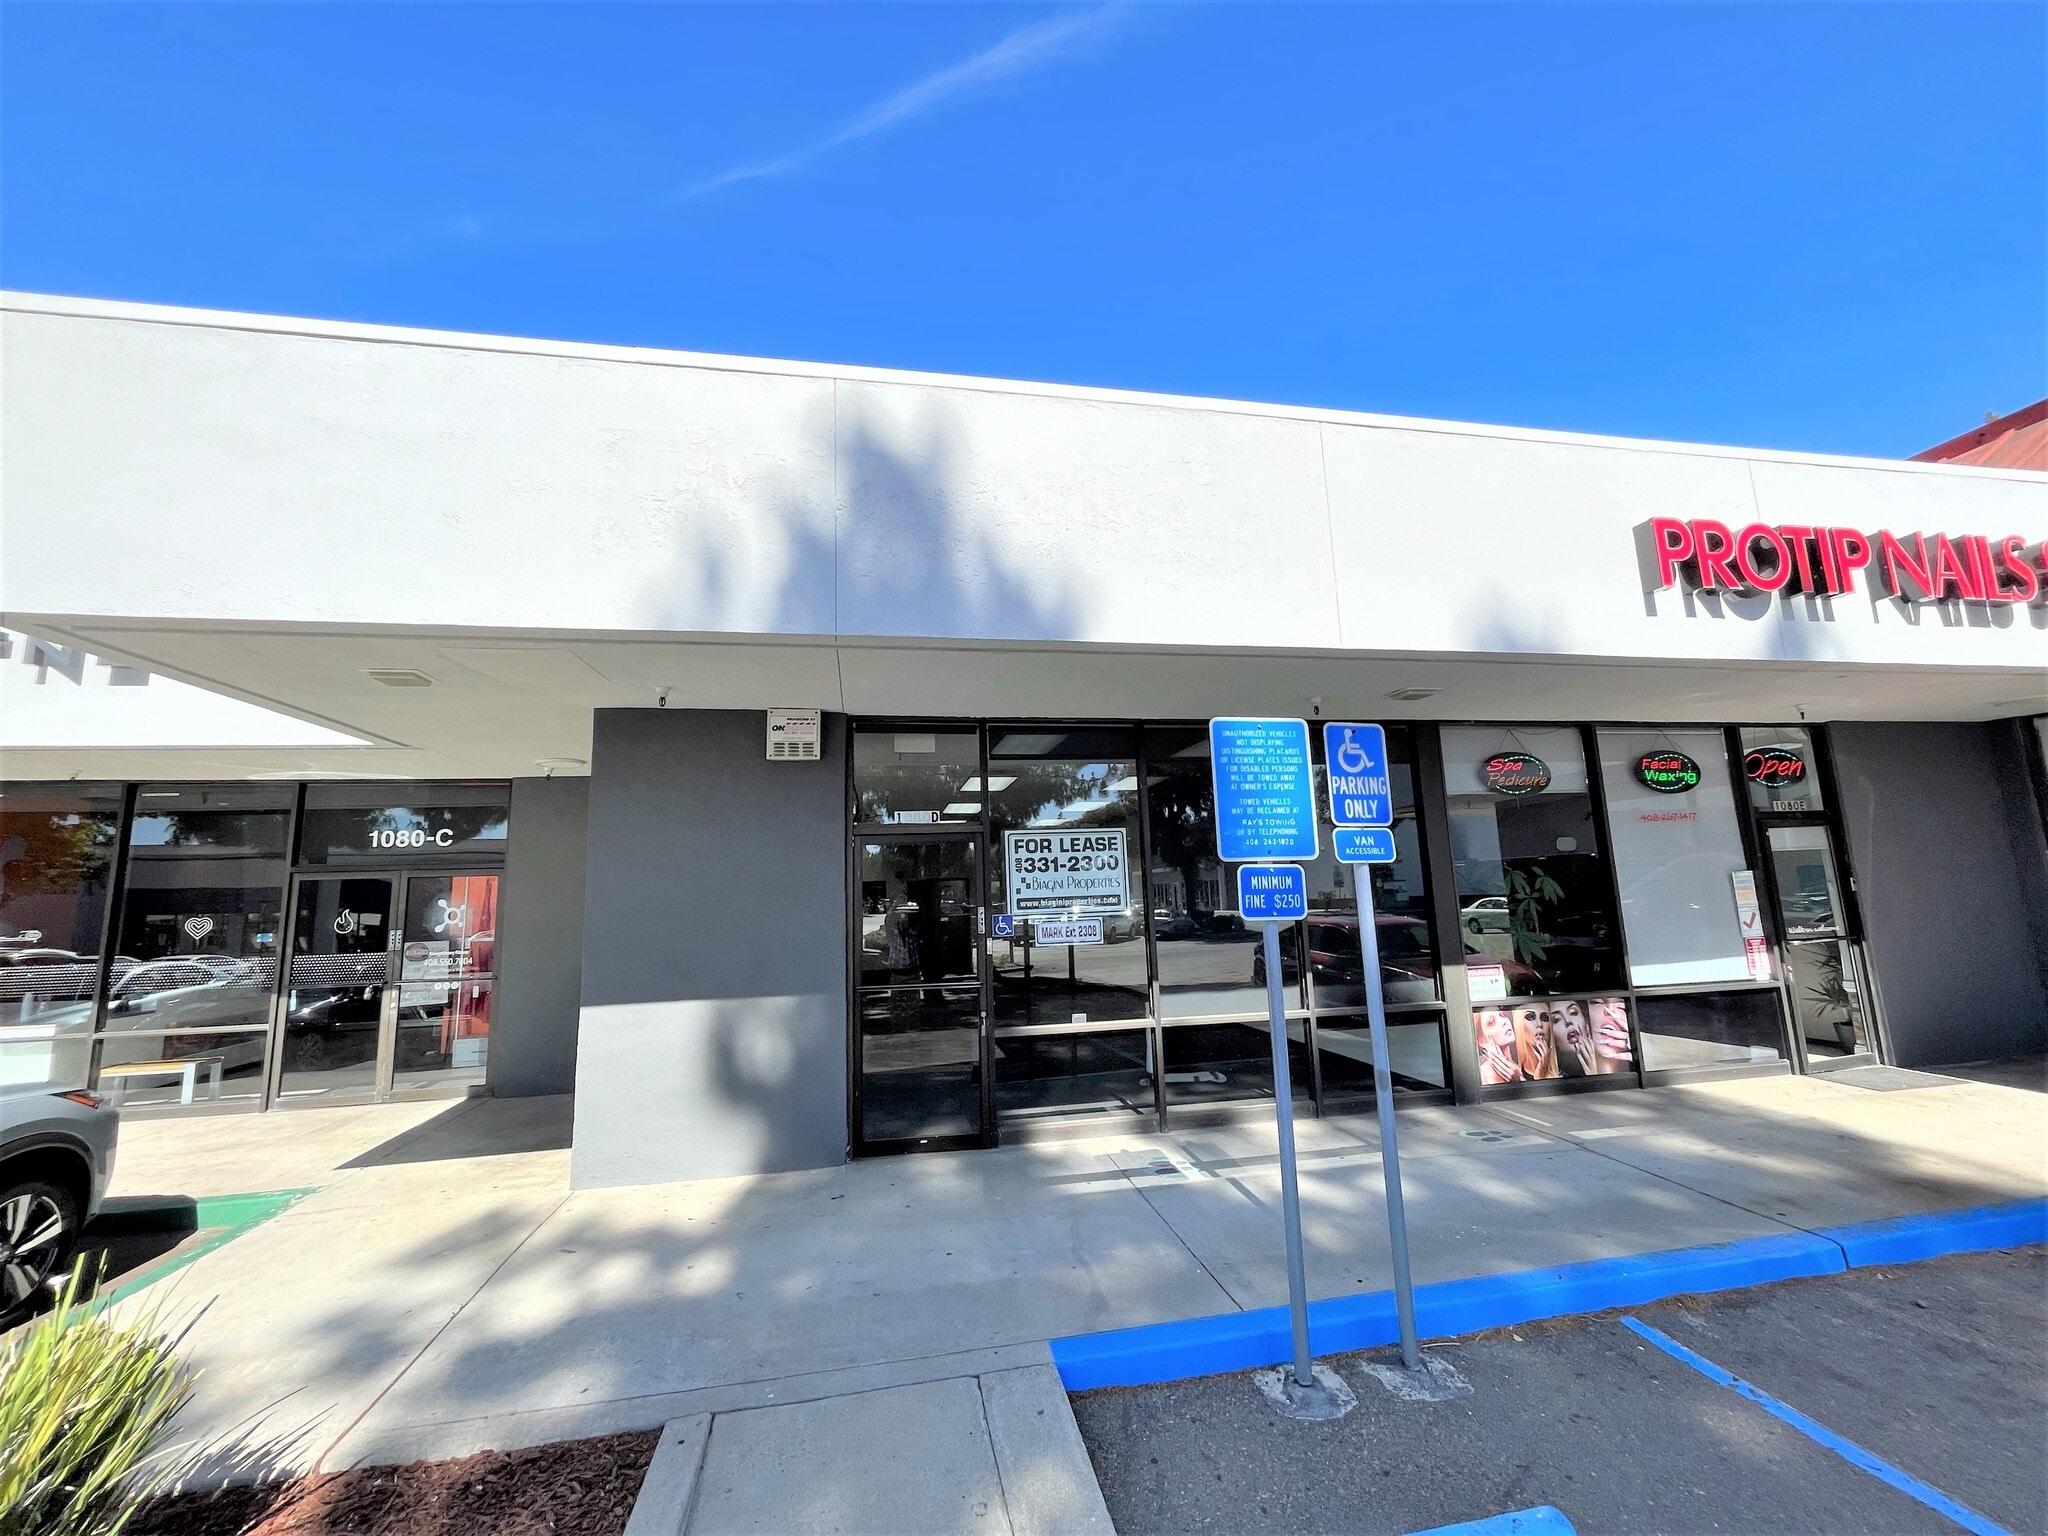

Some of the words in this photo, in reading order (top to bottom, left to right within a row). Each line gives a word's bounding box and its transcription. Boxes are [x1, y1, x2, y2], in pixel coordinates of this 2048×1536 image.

[1652, 517, 1872, 594] PROTIP
[1880, 529, 2039, 602] NAILS
[1221, 729, 1267, 738] UNAUTHORIZED
[1269, 730, 1297, 738] VEHICLES
[1221, 747, 1267, 755] DISTINGUISHING
[1268, 747, 1301, 755] PLACARDS
[1220, 756, 1229, 764] OR
[1230, 756, 1256, 764] LICENSE
[1257, 756, 1280, 764] PLATES
[1282, 756, 1303, 764] ISSUED
[1486, 758, 1523, 774] Spa
[1640, 758, 1682, 770] Facial
[1745, 753, 1803, 780] Open
[1226, 765, 1238, 773] FOR
[1240, 765, 1270, 773] DISABLED
[1271, 765, 1299, 773] PERSONS
[1230, 774, 1243, 782] WILL
[1246, 774, 1254, 782] BE
[1257, 774, 1278, 782] TOWED
[1280, 774, 1296, 782] AWAY
[1487, 772, 1549, 788] Pedicure
[1644, 769, 1697, 784] Waxing
[1240, 783, 1267, 791] OWNER'S
[1269, 783, 1296, 791] EXPENSE
[1332, 776, 1387, 795] PARKING
[1262, 797, 1292, 805] VEHICLES
[1775, 801, 1806, 811] 1080E
[1292, 806, 1300, 814] AT
[1344, 799, 1378, 818] ONLY
[1241, 818, 1263, 826] RAY'S
[1264, 818, 1296, 826] TOWING
[368, 828, 454, 848] 1080-C
[1247, 828, 1256, 836] BY
[1259, 828, 1299, 836] TELEPHONING
[1014, 838, 1052, 854] FOR
[1059, 836, 1119, 853] LEASE
[1354, 835, 1375, 846] VAN
[1345, 847, 1386, 855] ACCESSIBLE
[1015, 857, 1023, 873] 408
[1023, 854, 1120, 873] 331-2300
[1250, 875, 1293, 890] MINIMUM
[1245, 894, 1267, 909] FINE
[1273, 894, 1301, 909] $250
[1041, 926, 1063, 938] MARK
[1078, 924, 1097, 938] 2308
